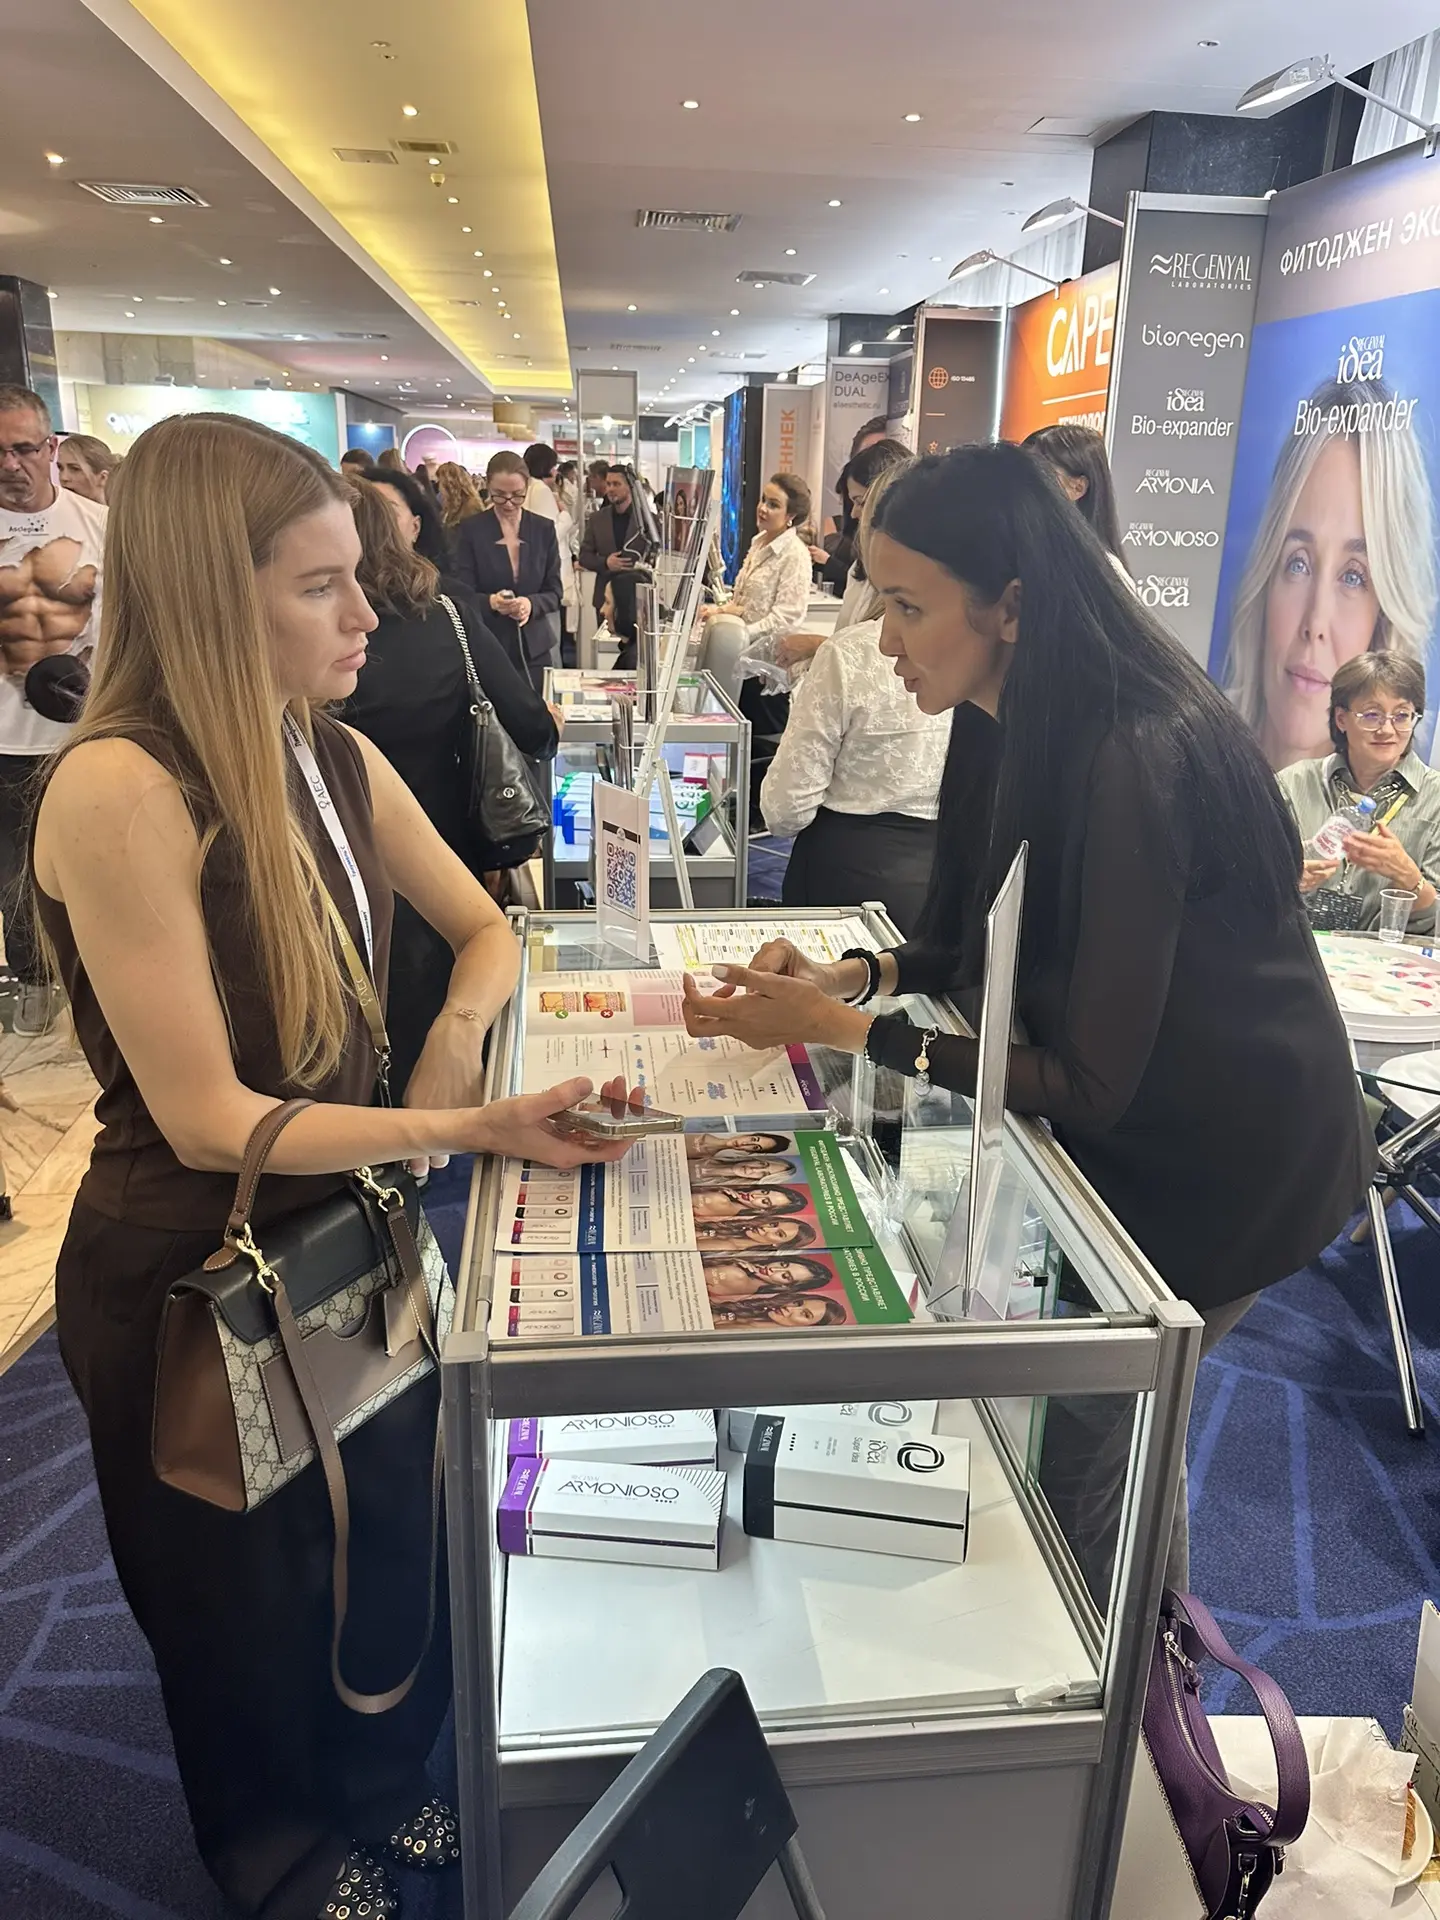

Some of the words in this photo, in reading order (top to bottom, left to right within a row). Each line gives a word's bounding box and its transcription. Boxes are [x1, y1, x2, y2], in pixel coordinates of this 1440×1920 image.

[1280, 217, 1393, 275] ФИТОДЖЕН
[1171, 254, 1252, 281] REGENYAL
[1171, 280, 1252, 291] LABORATORIES
[1142, 324, 1244, 357] bioregen
[1336, 336, 1384, 384] idea
[834, 386, 866, 397] DUAL
[1166, 388, 1205, 412] idea
[1131, 415, 1234, 439] Bio-expander
[1294, 391, 1418, 441] Bio-expander
[1136, 477, 1215, 494] ARMONIA
[1121, 530, 1219, 547] ARMONIOSO
[310, 775, 327, 801] AEC
[854, 1277, 870, 1302] РОССИИ
[862, 1265, 888, 1311] ПРЕДСТАВЛЯЕТ
[560, 1413, 675, 1431] ARMONIOSO
[840, 1404, 854, 1416] ea
[852, 1436, 863, 1452] Super
[867, 1439, 889, 1464] idea
[851, 1452, 861, 1463] idea
[557, 1480, 680, 1500] ARMONIOSO
